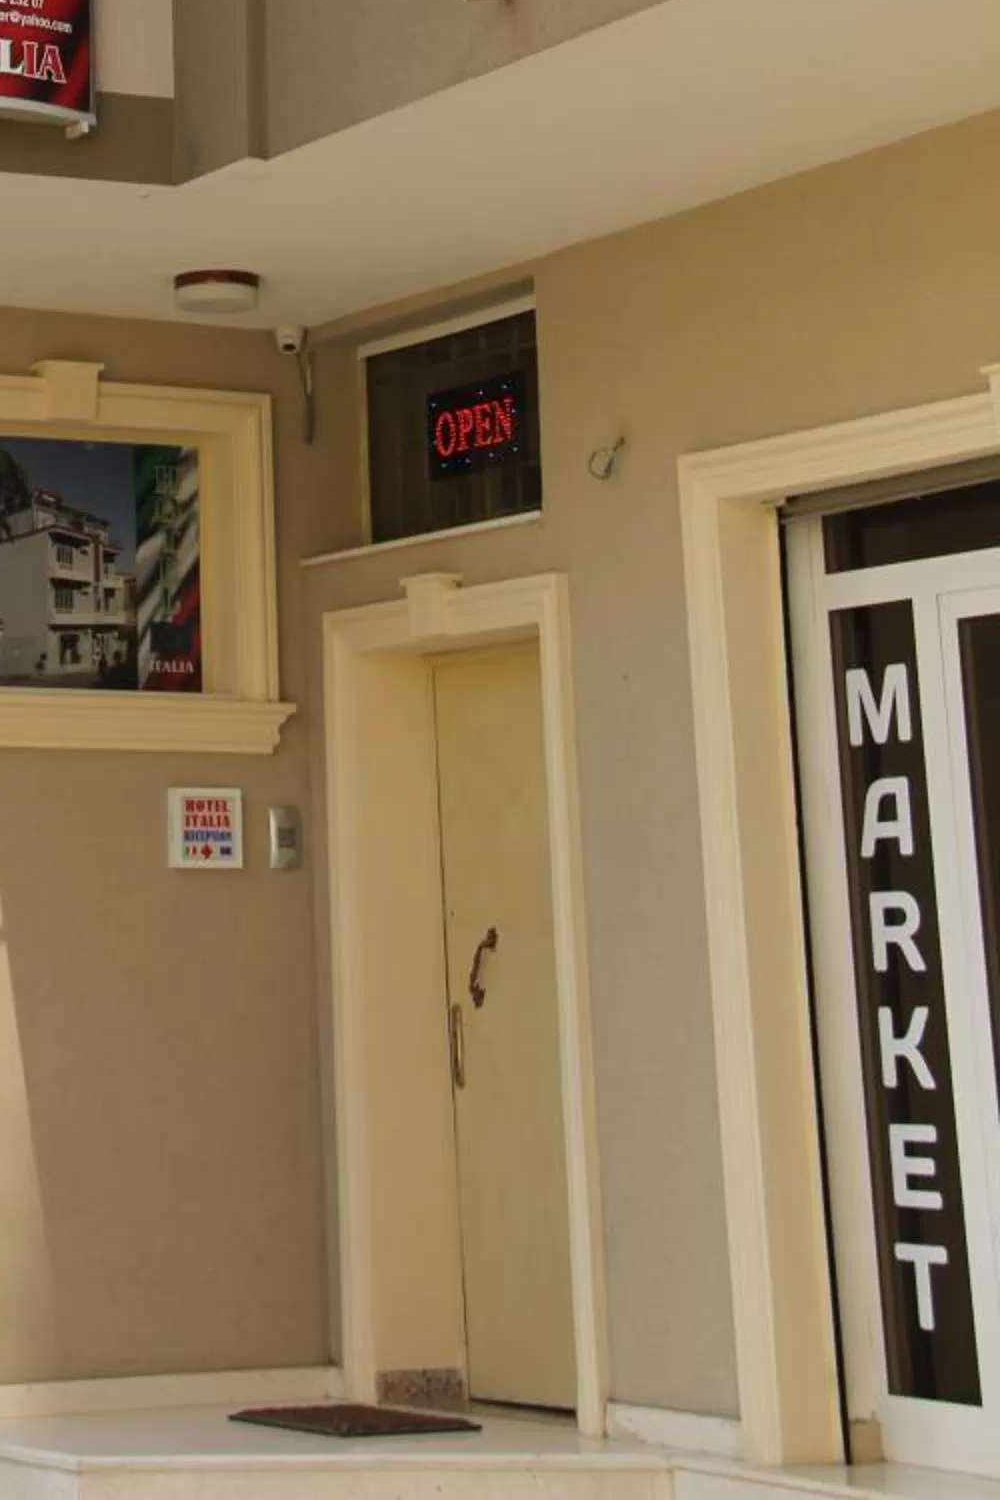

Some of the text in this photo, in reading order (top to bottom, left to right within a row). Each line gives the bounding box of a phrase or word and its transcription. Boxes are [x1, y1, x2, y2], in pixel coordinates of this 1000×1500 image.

[436, 397, 512, 457] OPEN
[150, 656, 194, 674] ITALIA
[185, 799, 230, 813] HOTEL
[185, 814, 231, 828] ITALIA
[845, 663, 948, 1331] MARKET
